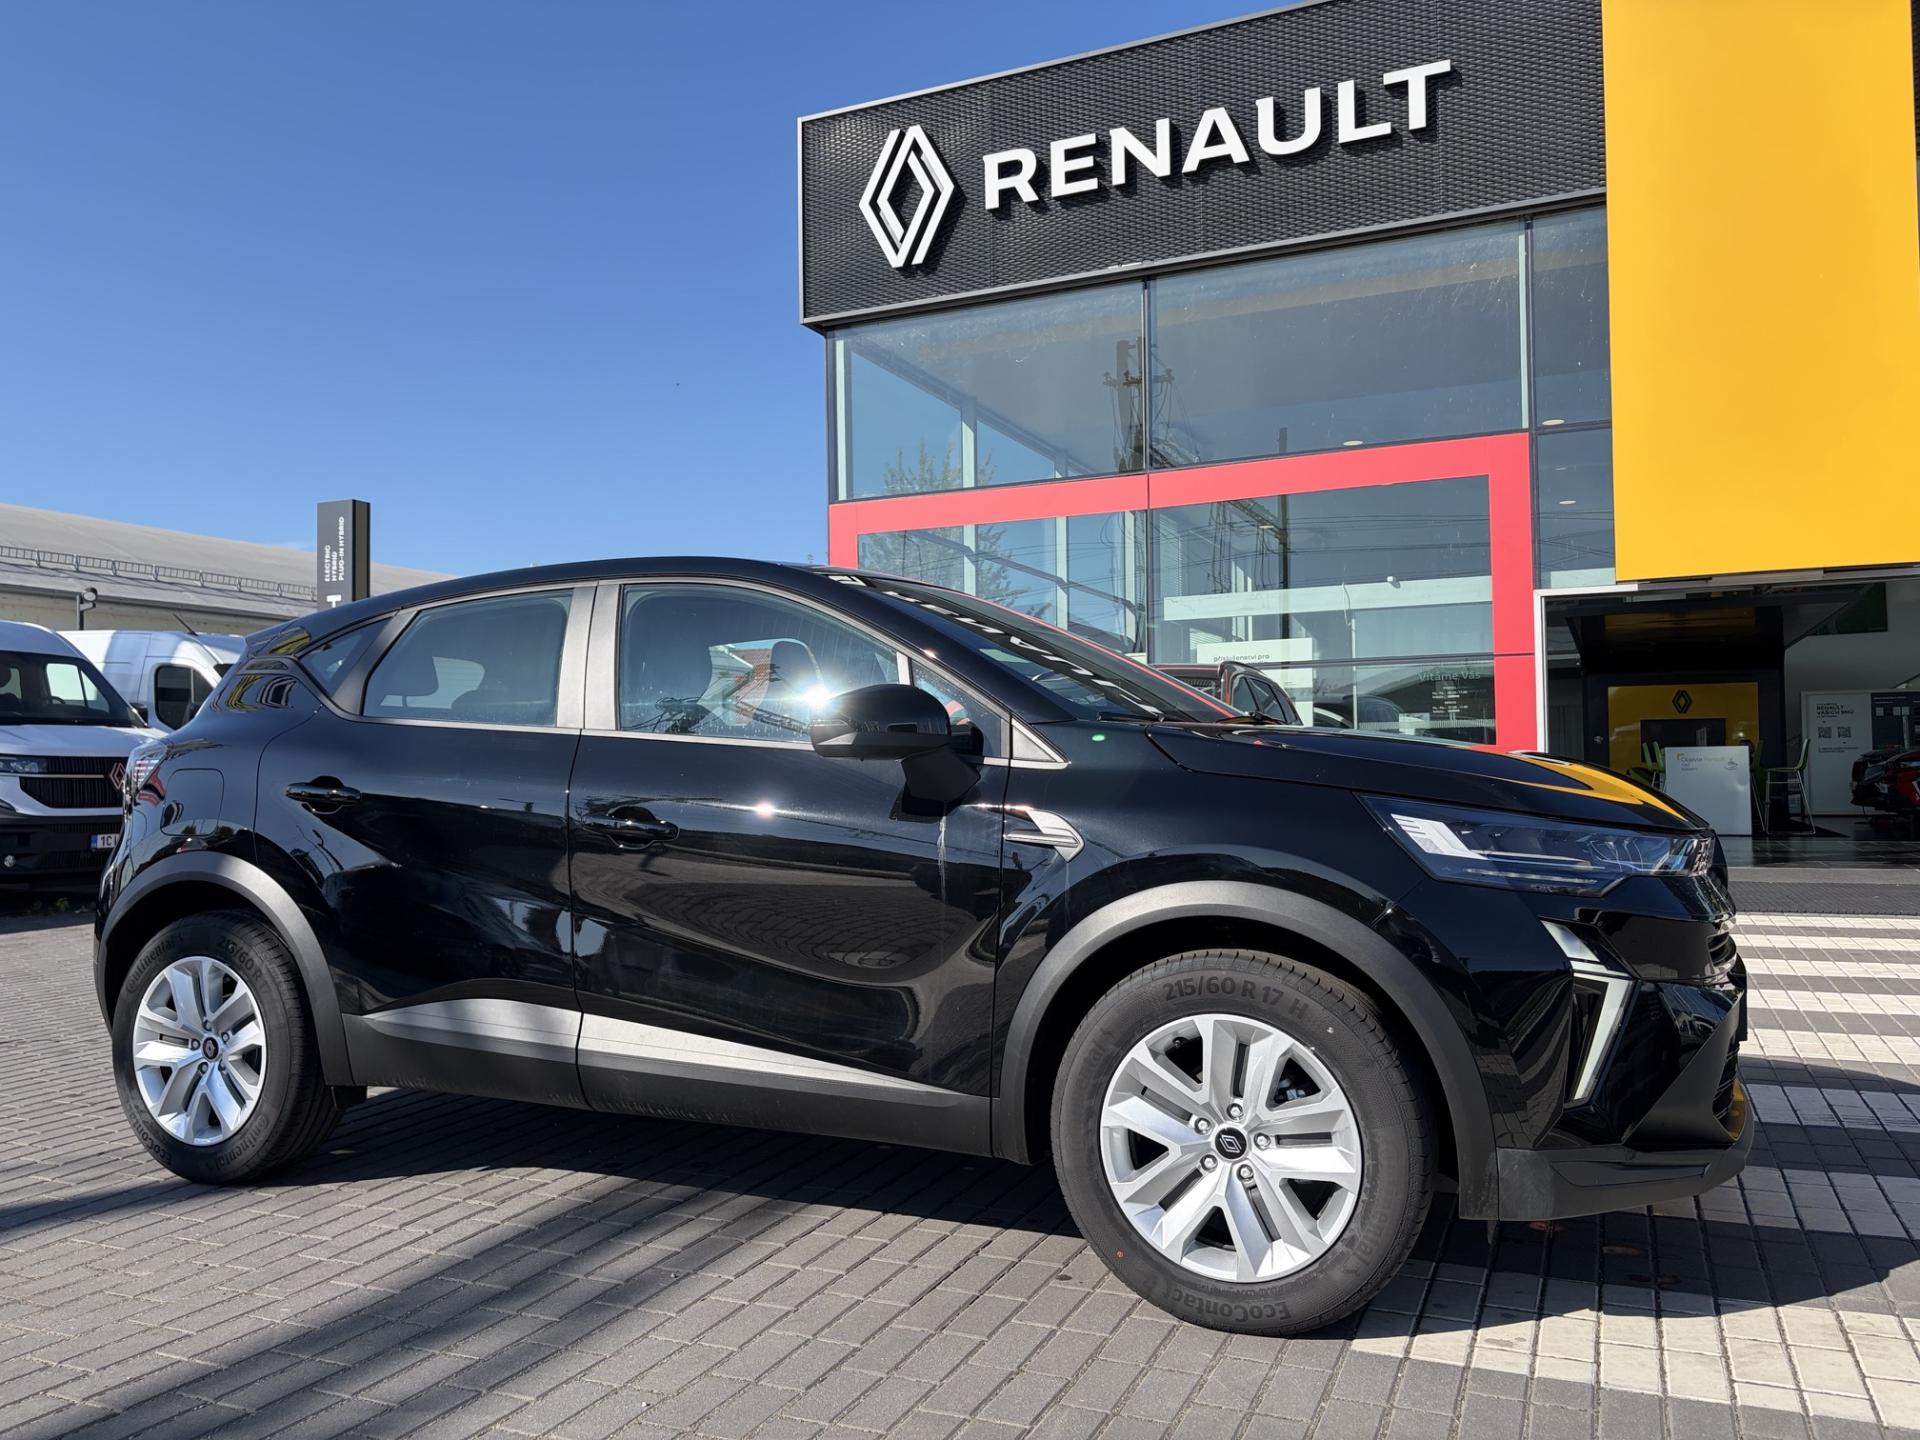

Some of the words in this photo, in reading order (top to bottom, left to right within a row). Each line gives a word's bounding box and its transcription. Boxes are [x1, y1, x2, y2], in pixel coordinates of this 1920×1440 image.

[983, 59, 1452, 211] RENAULT
[1162, 976, 1236, 1001] 215/60
[1241, 980, 1257, 1000] R
[1262, 986, 1284, 1006] 17
[1163, 1279, 1291, 1324] EcoContact
